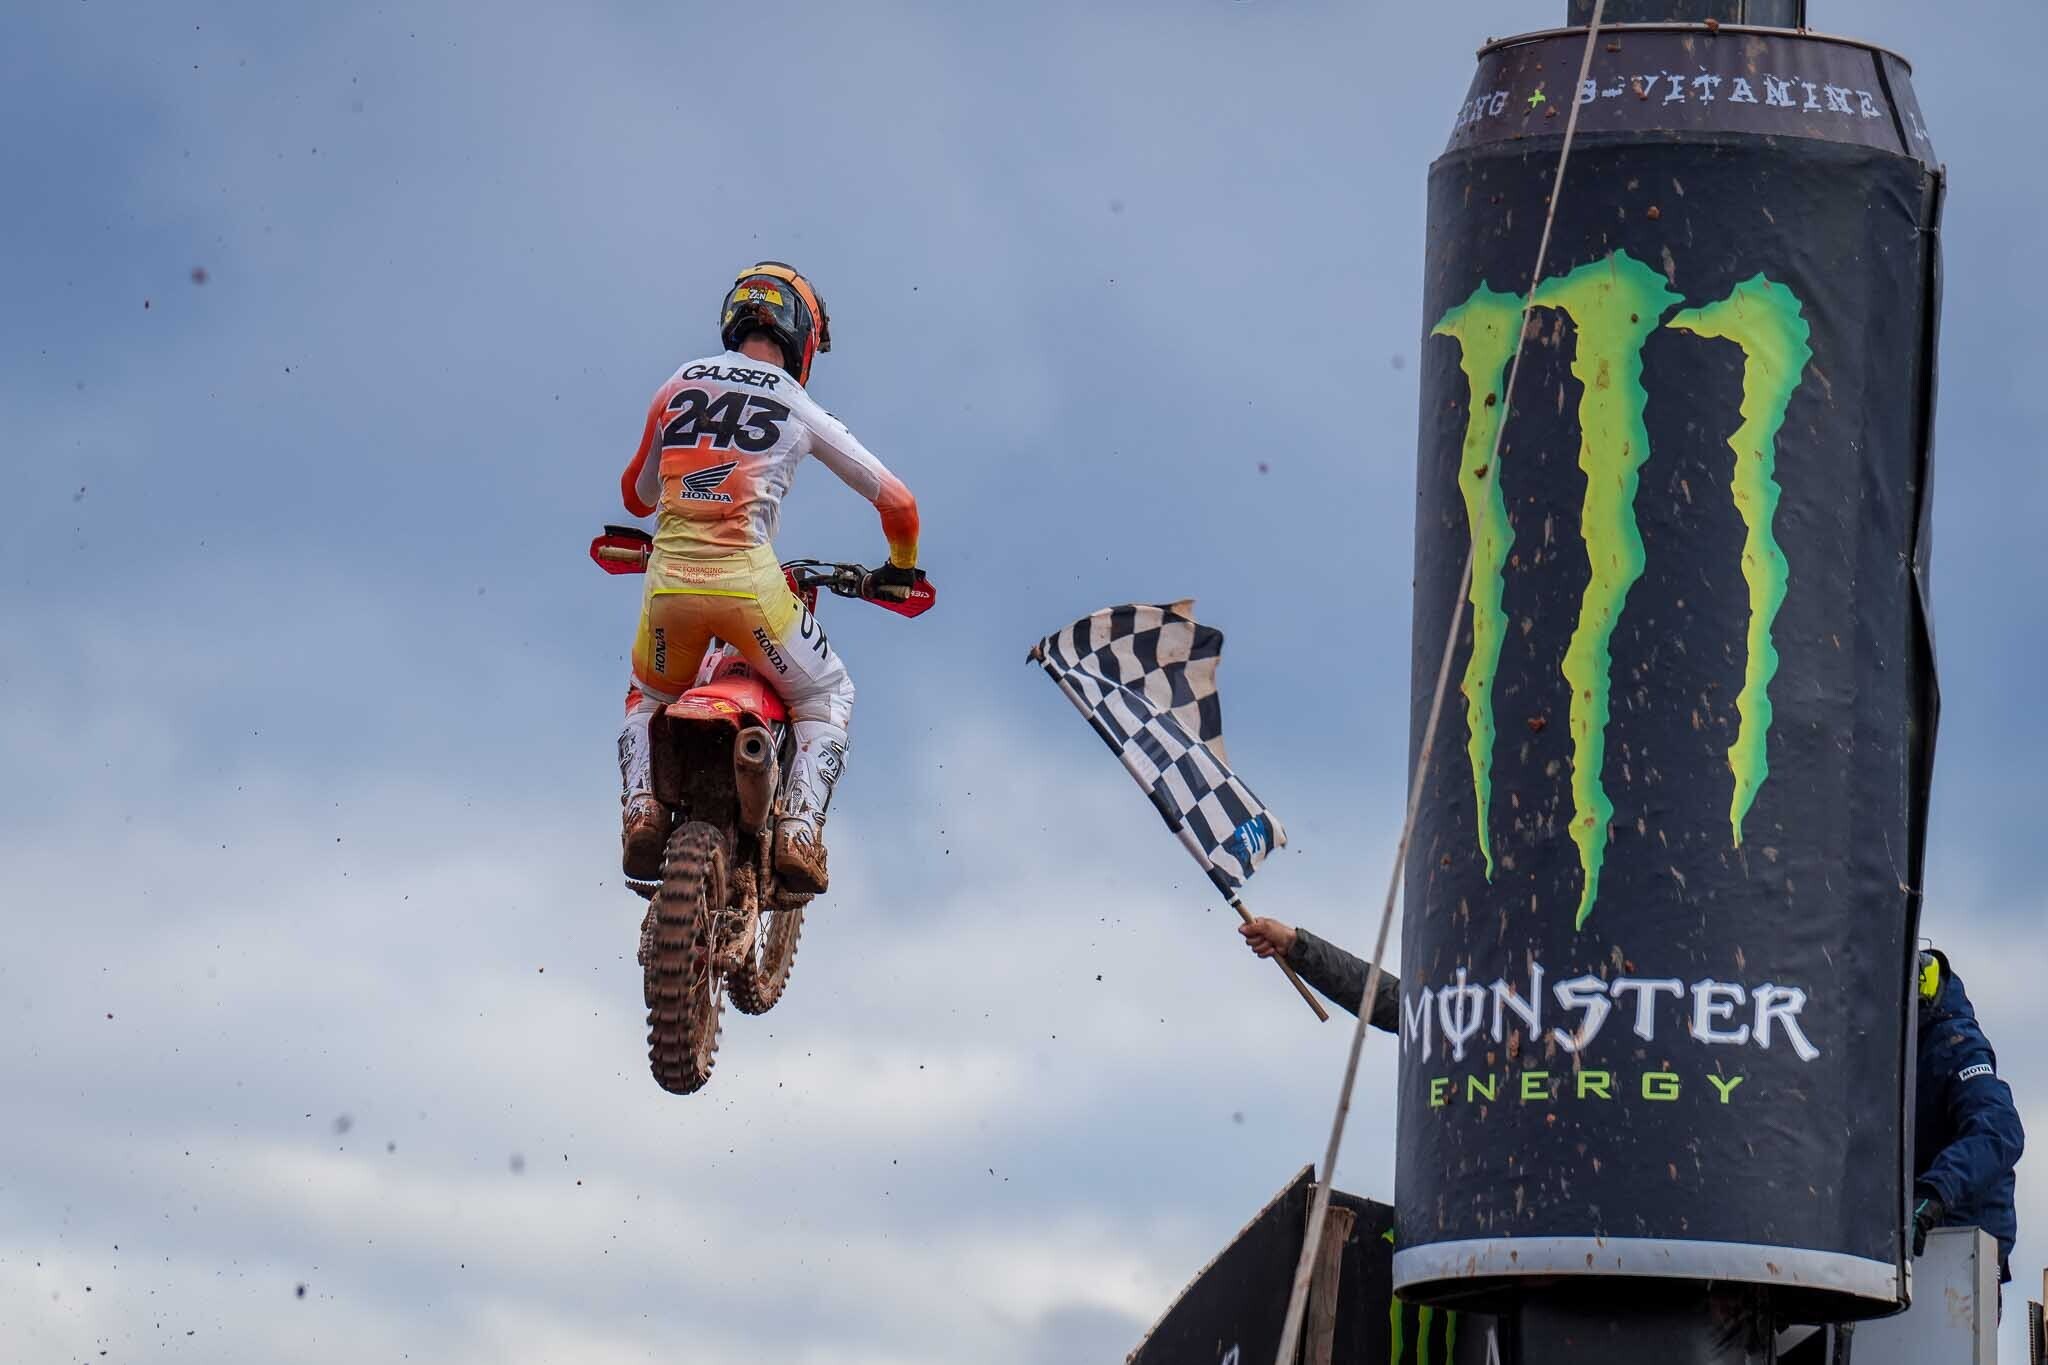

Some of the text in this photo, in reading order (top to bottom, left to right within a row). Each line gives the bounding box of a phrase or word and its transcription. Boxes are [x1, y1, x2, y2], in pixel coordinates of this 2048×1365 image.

[682, 365, 780, 391] GAJSER
[663, 389, 791, 452] 243
[681, 491, 732, 502] HONDA
[655, 627, 666, 673] HONDA
[752, 627, 789, 675] HONDA
[796, 600, 828, 660] OX
[817, 750, 840, 775] FOX
[1403, 961, 1821, 1063] MONSTER
[1430, 1070, 1745, 1107] ENERGY
